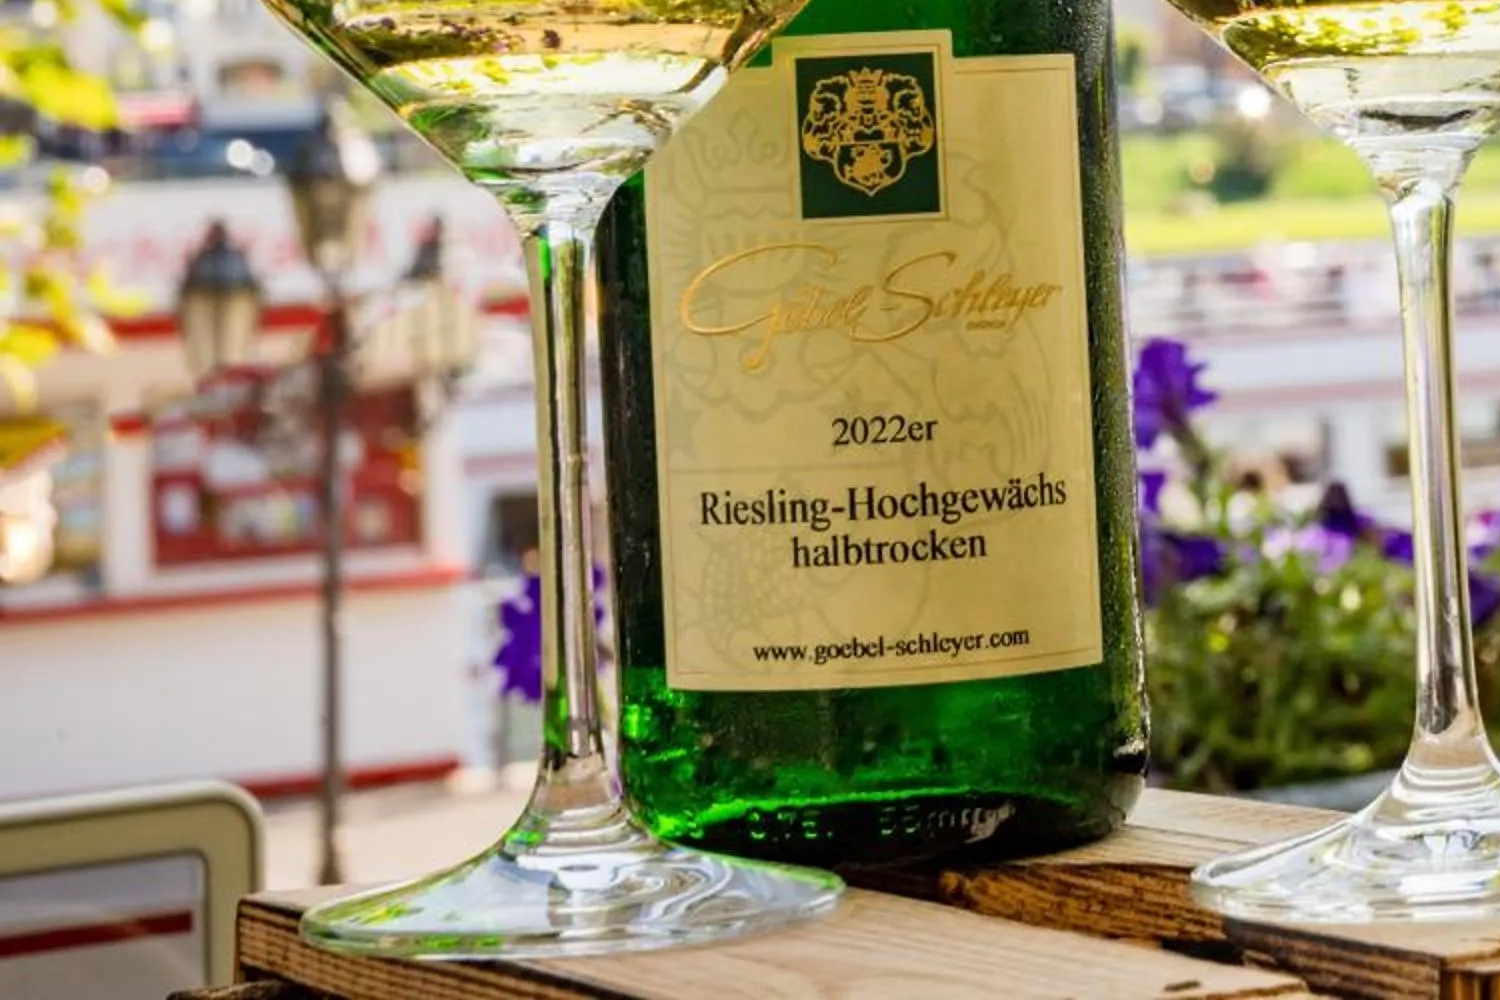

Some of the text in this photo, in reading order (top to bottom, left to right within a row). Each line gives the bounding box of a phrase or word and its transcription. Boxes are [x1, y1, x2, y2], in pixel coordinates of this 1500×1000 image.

[832, 415, 938, 446] 2022er
[701, 472, 1067, 532] Riesling-Hochgewächs
[791, 529, 987, 569] halbtrocken
[753, 629, 1030, 665] www.goebel-schleyer.com
